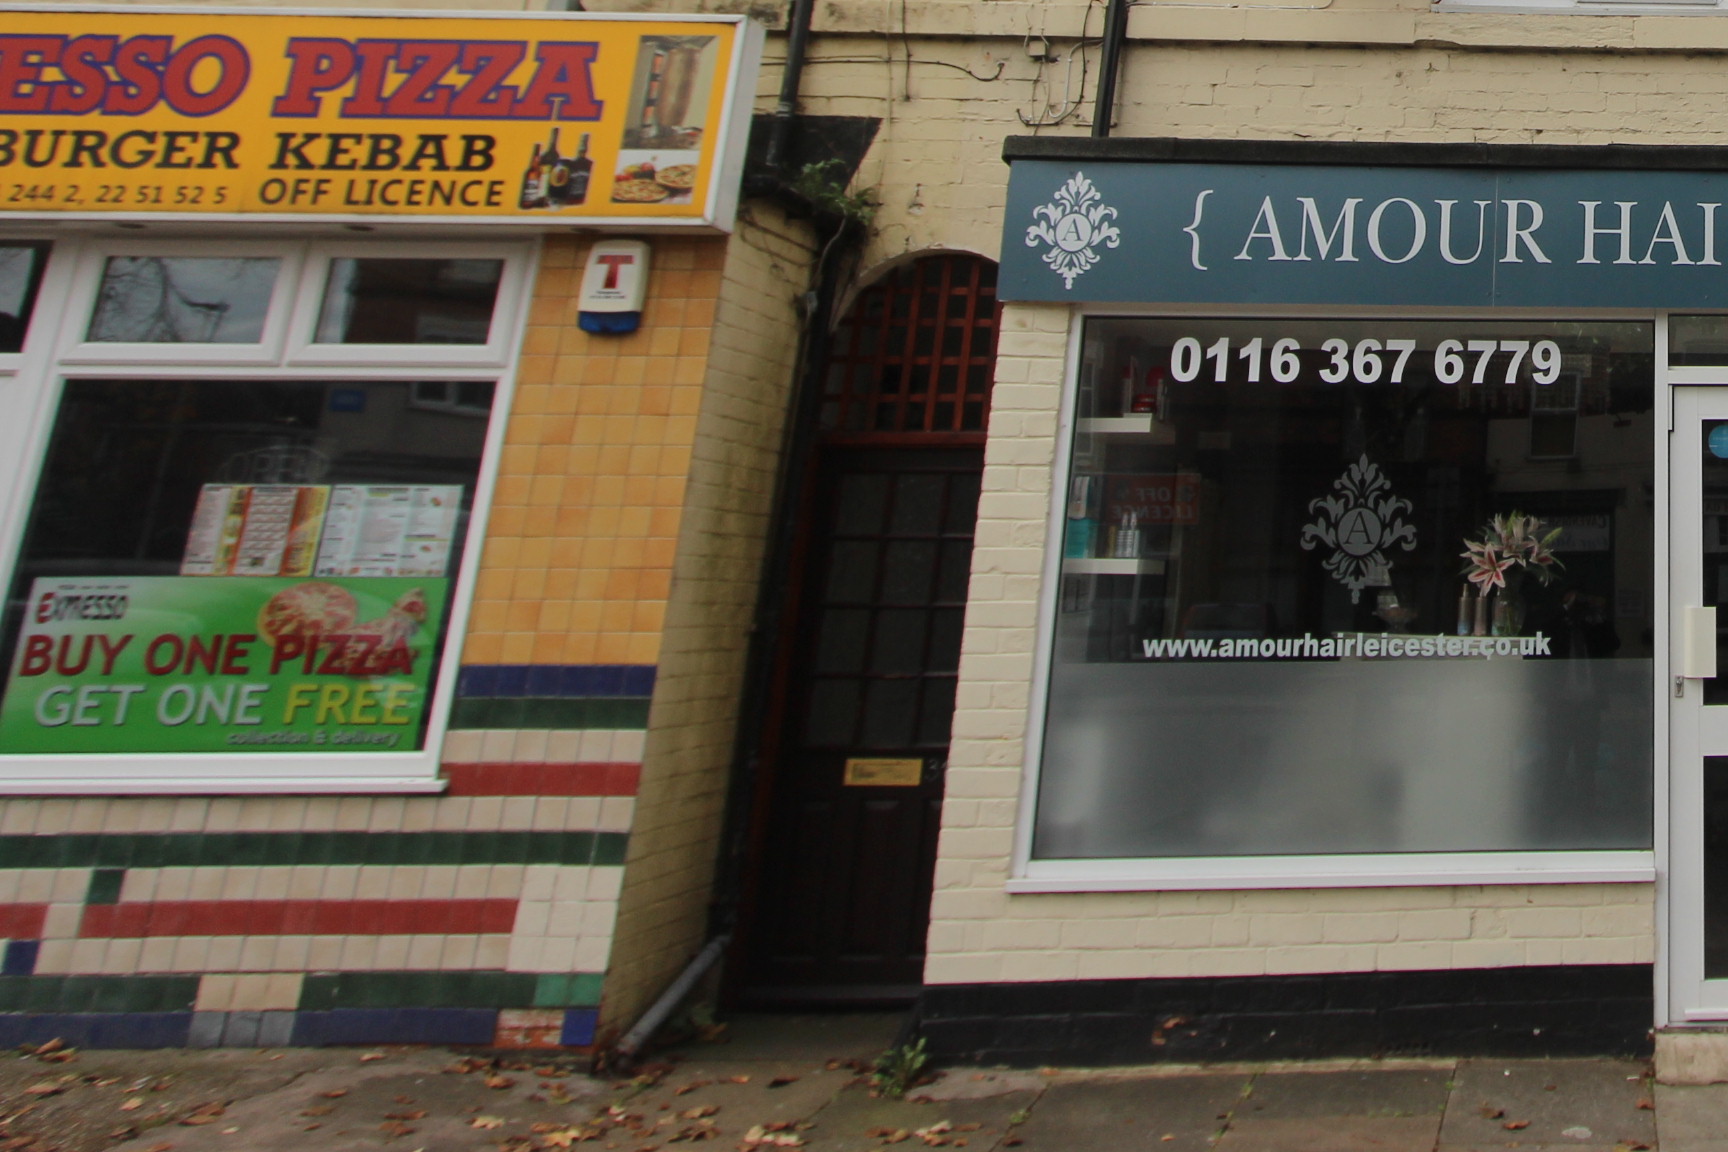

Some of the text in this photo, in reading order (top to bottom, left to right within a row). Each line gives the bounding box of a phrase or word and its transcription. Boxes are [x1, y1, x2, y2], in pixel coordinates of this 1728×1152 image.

[0, 34, 605, 123] ESSO PIZZA
[268, 132, 496, 172] KEBAB
[9, 184, 55, 202] 244
[95, 185, 126, 203] 22
[135, 186, 163, 204] 51
[174, 186, 204, 204] 52
[213, 186, 227, 204] 5
[259, 178, 504, 207] OFF LICENCE
[1062, 218, 1085, 242] A
[1233, 196, 1552, 265] AMOUR
[1170, 336, 1562, 385] 0116 367 6779
[1344, 509, 1375, 547] A
[19, 634, 413, 677] BUY ONE PIZZA
[1143, 632, 1552, 658] www.amourhairleicester.co.uk
[34, 684, 416, 727] GET ONE FREE
[332, 730, 401, 748] delivery
